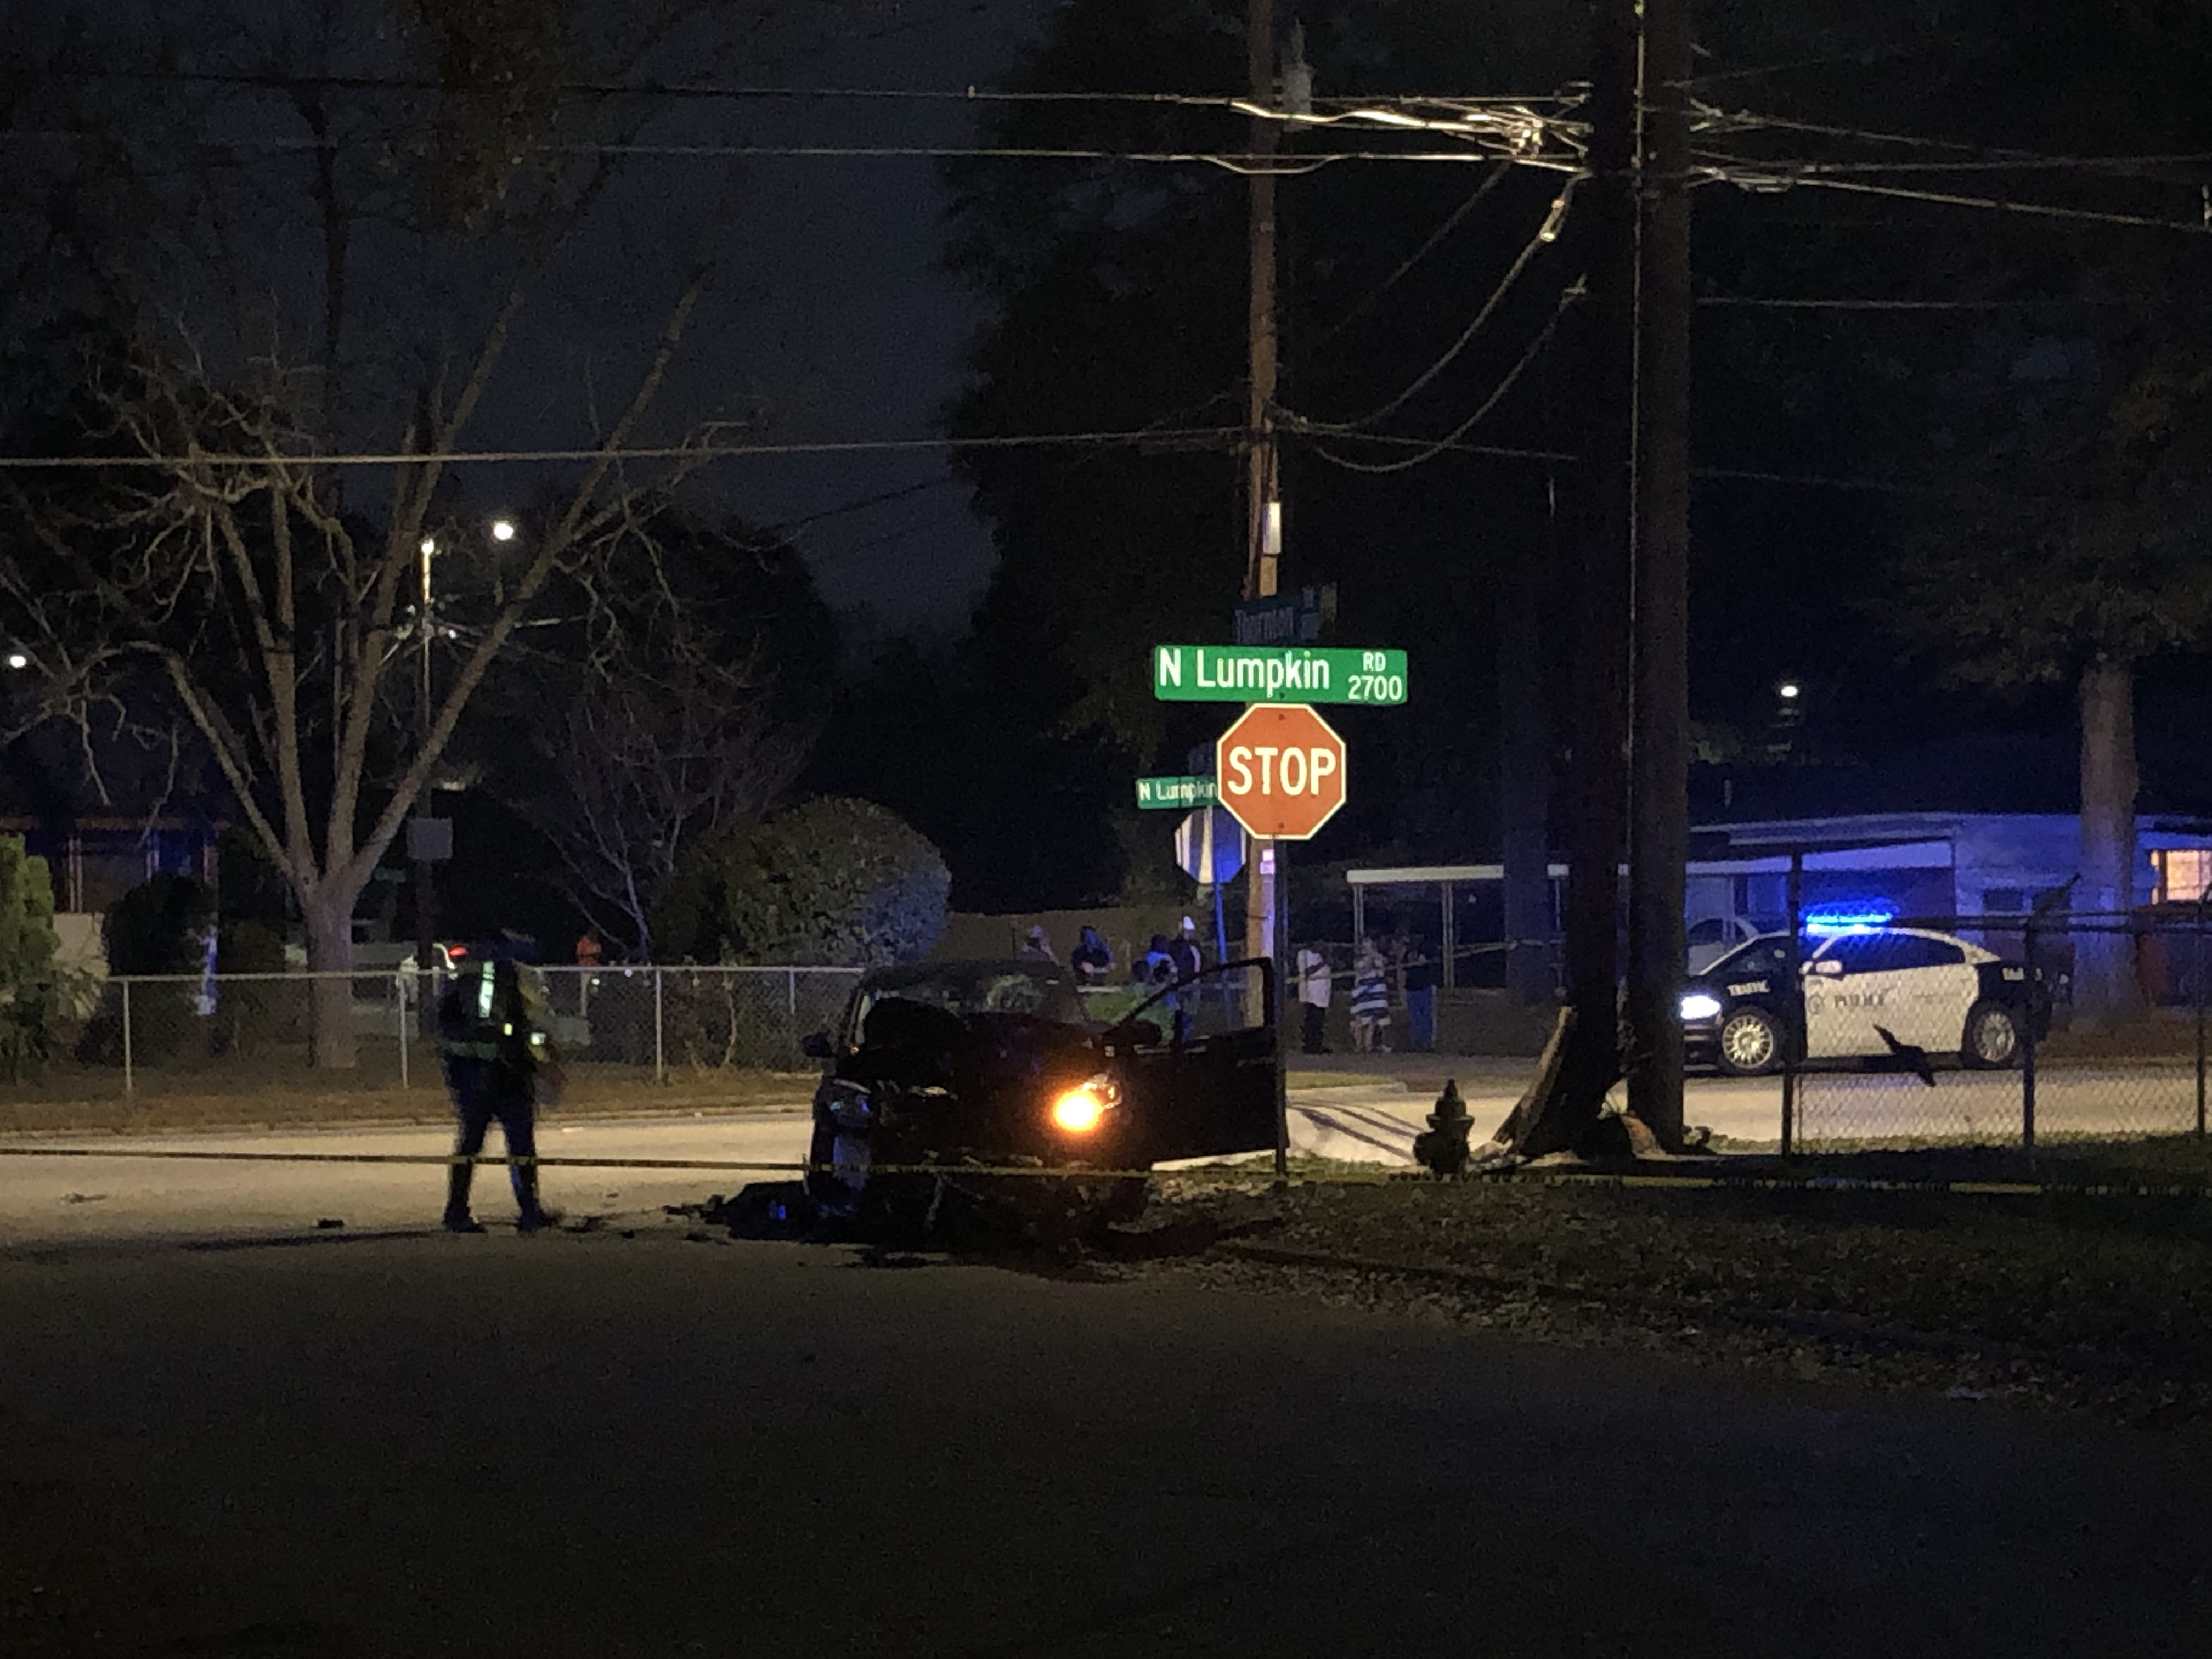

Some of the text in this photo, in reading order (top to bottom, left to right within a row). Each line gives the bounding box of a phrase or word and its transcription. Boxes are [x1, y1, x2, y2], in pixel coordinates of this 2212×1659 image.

[1160, 648, 1386, 698] N Lumpkin RD
[1348, 675, 1403, 701] 2700
[1228, 746, 1336, 795] STOP
[1138, 781, 1151, 801] N
